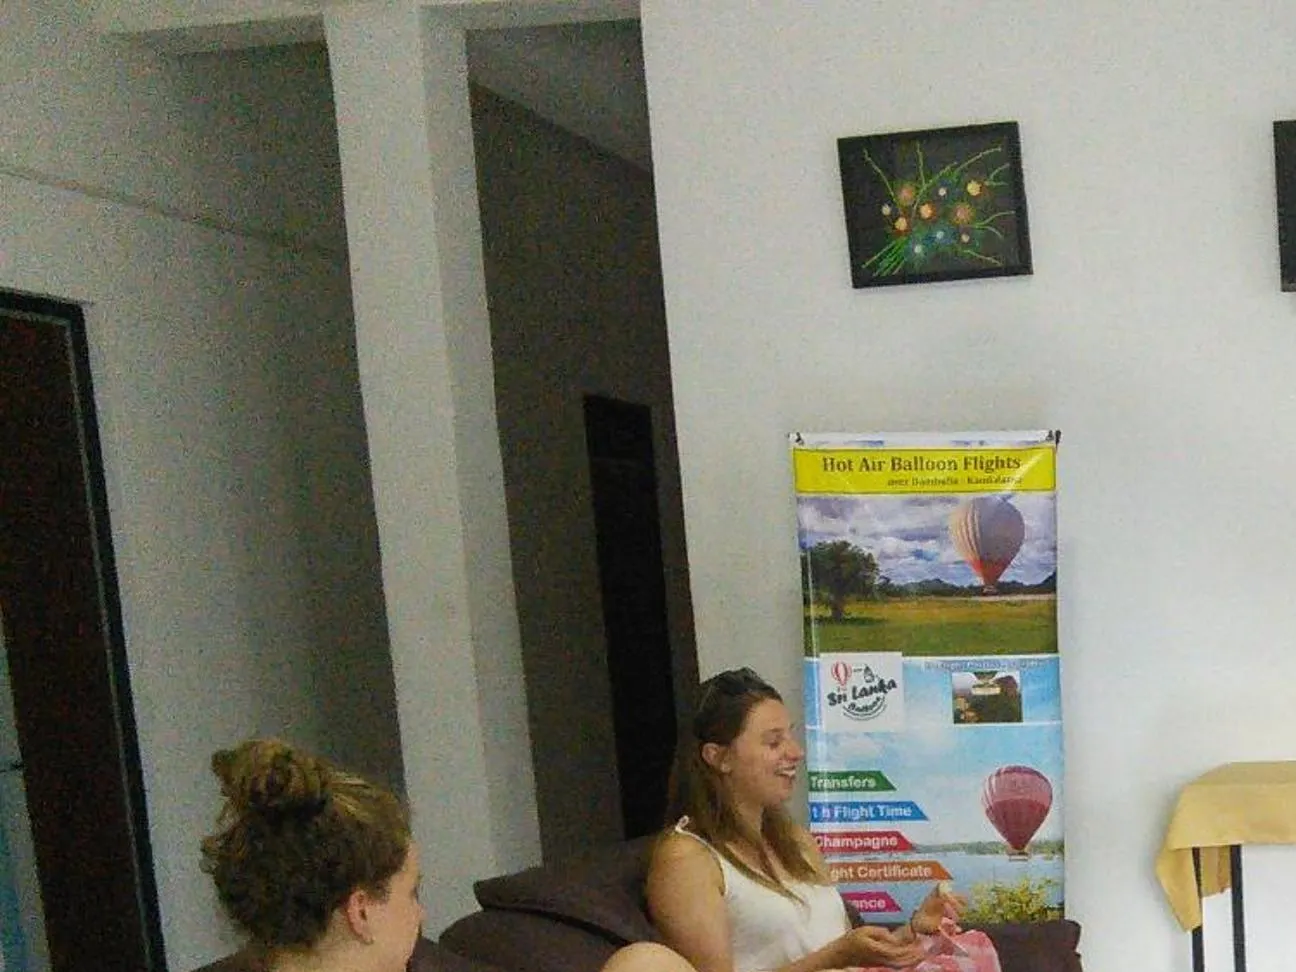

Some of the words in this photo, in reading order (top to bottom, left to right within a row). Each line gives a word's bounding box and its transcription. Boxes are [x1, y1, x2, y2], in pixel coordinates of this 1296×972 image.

[823, 456, 853, 472] Hot
[859, 456, 885, 472] Air
[891, 456, 958, 472] Balloon
[963, 455, 1021, 474] Flights
[827, 686, 848, 706] Sri
[852, 678, 897, 700] Lanka
[810, 775, 876, 789] Transfers
[833, 804, 875, 820] Flight
[877, 803, 913, 817] Time
[816, 834, 898, 850] Champagne
[857, 864, 932, 879] Certificate
